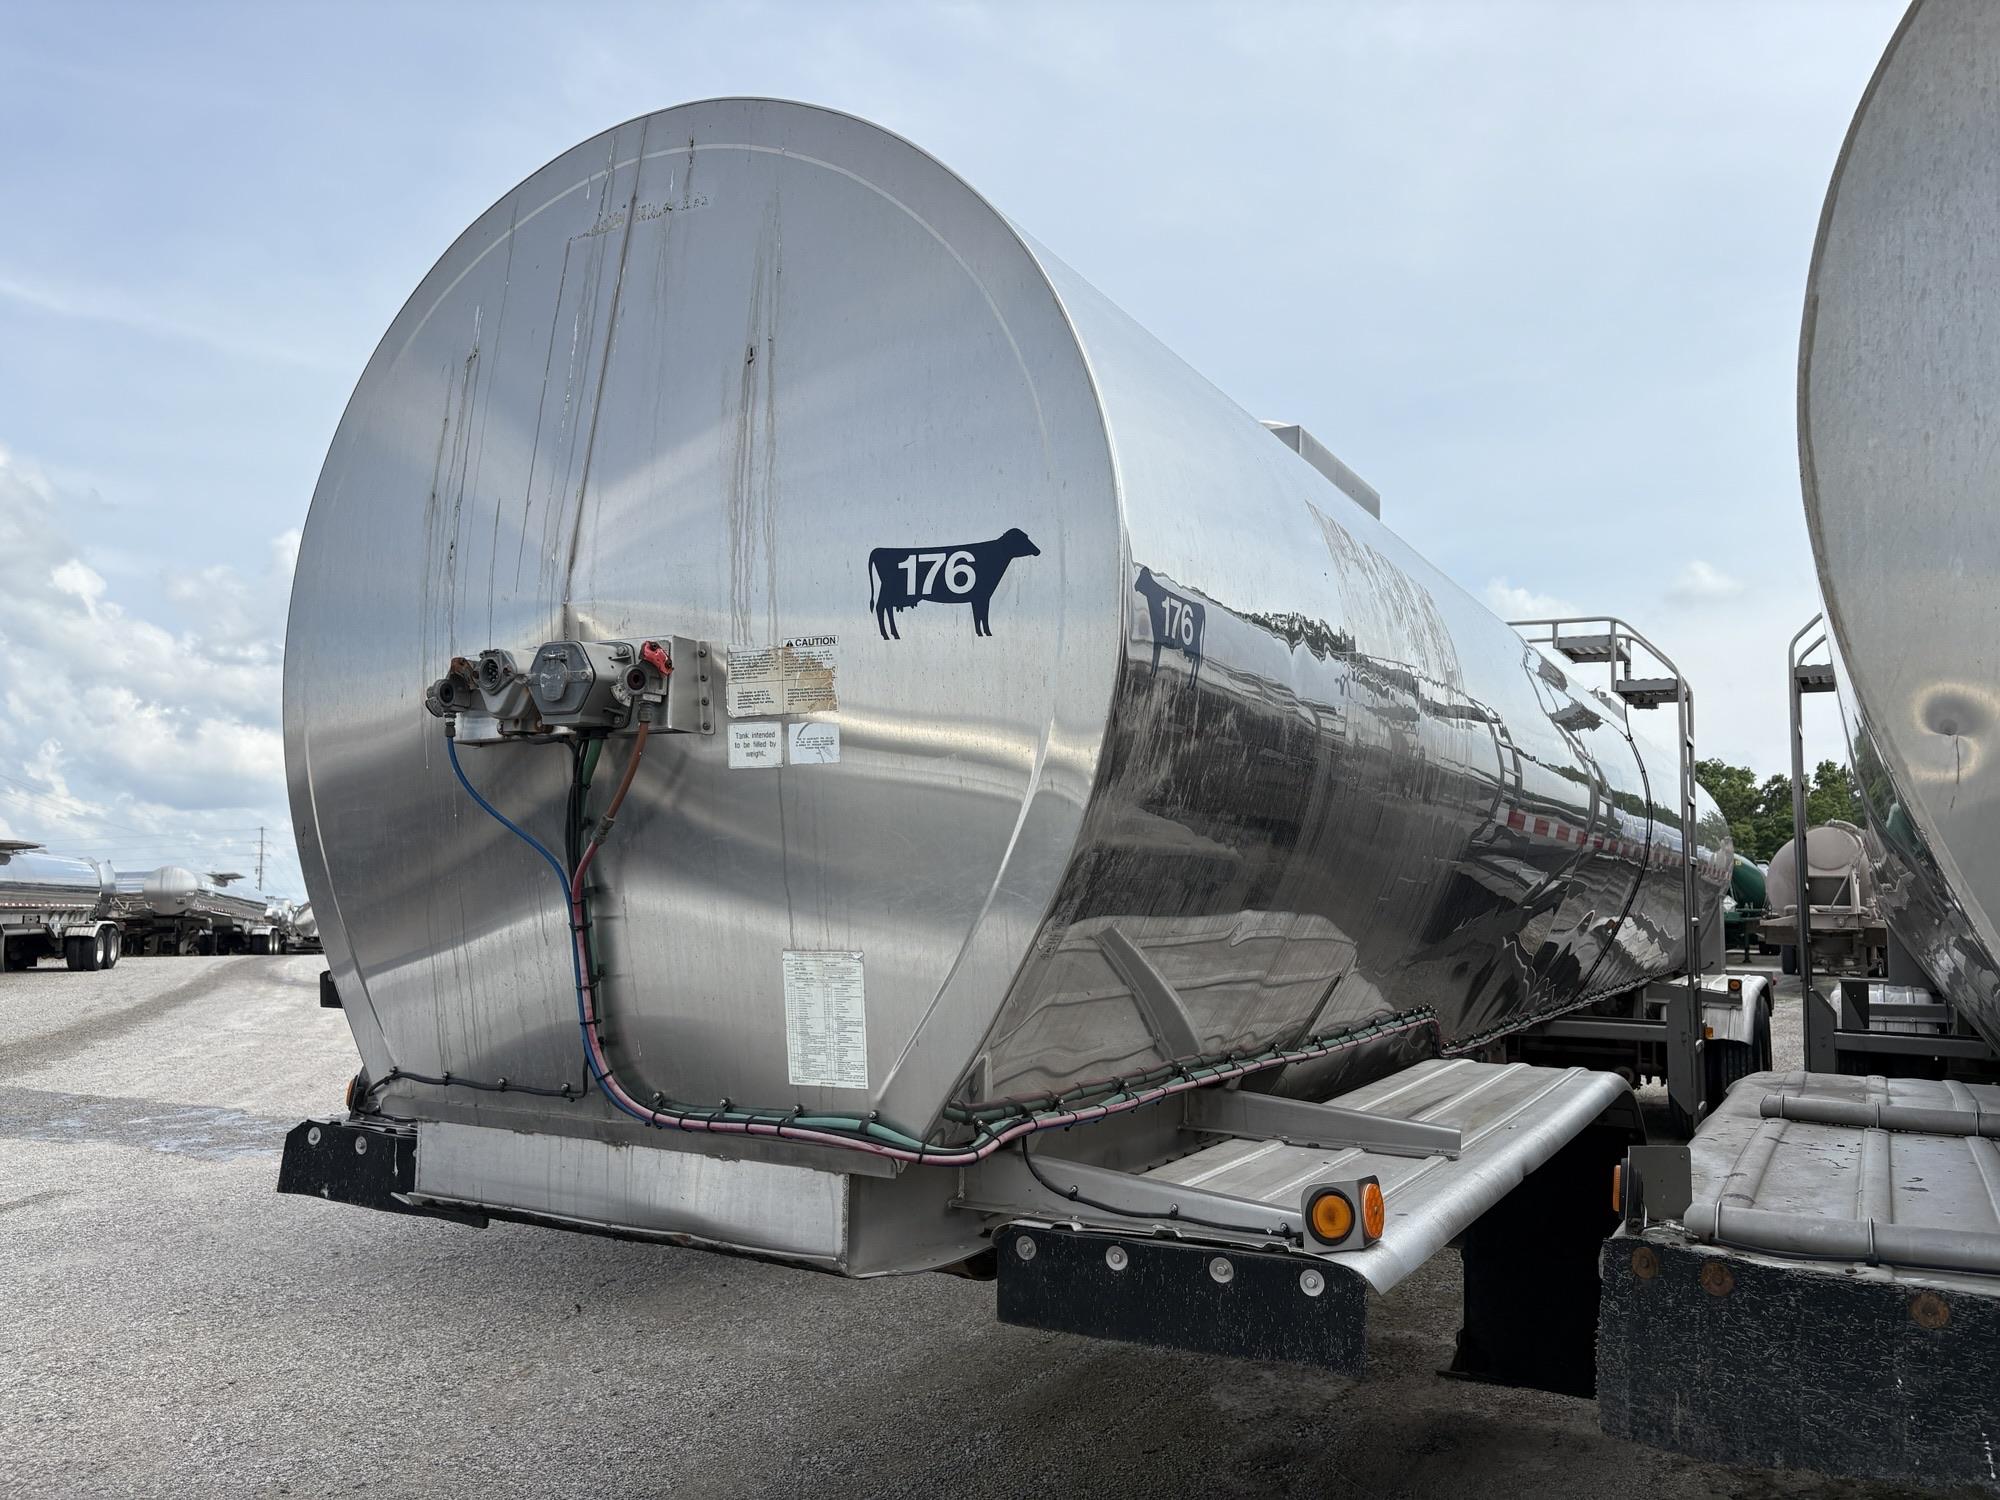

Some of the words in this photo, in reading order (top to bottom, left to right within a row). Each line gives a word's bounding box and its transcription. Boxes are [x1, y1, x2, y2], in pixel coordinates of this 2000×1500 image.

[897, 550, 976, 596] 176
[1160, 596, 1194, 646] 176
[795, 636, 836, 647] CAUTION
[752, 731, 775, 739] intended
[769, 741, 777, 749] by
